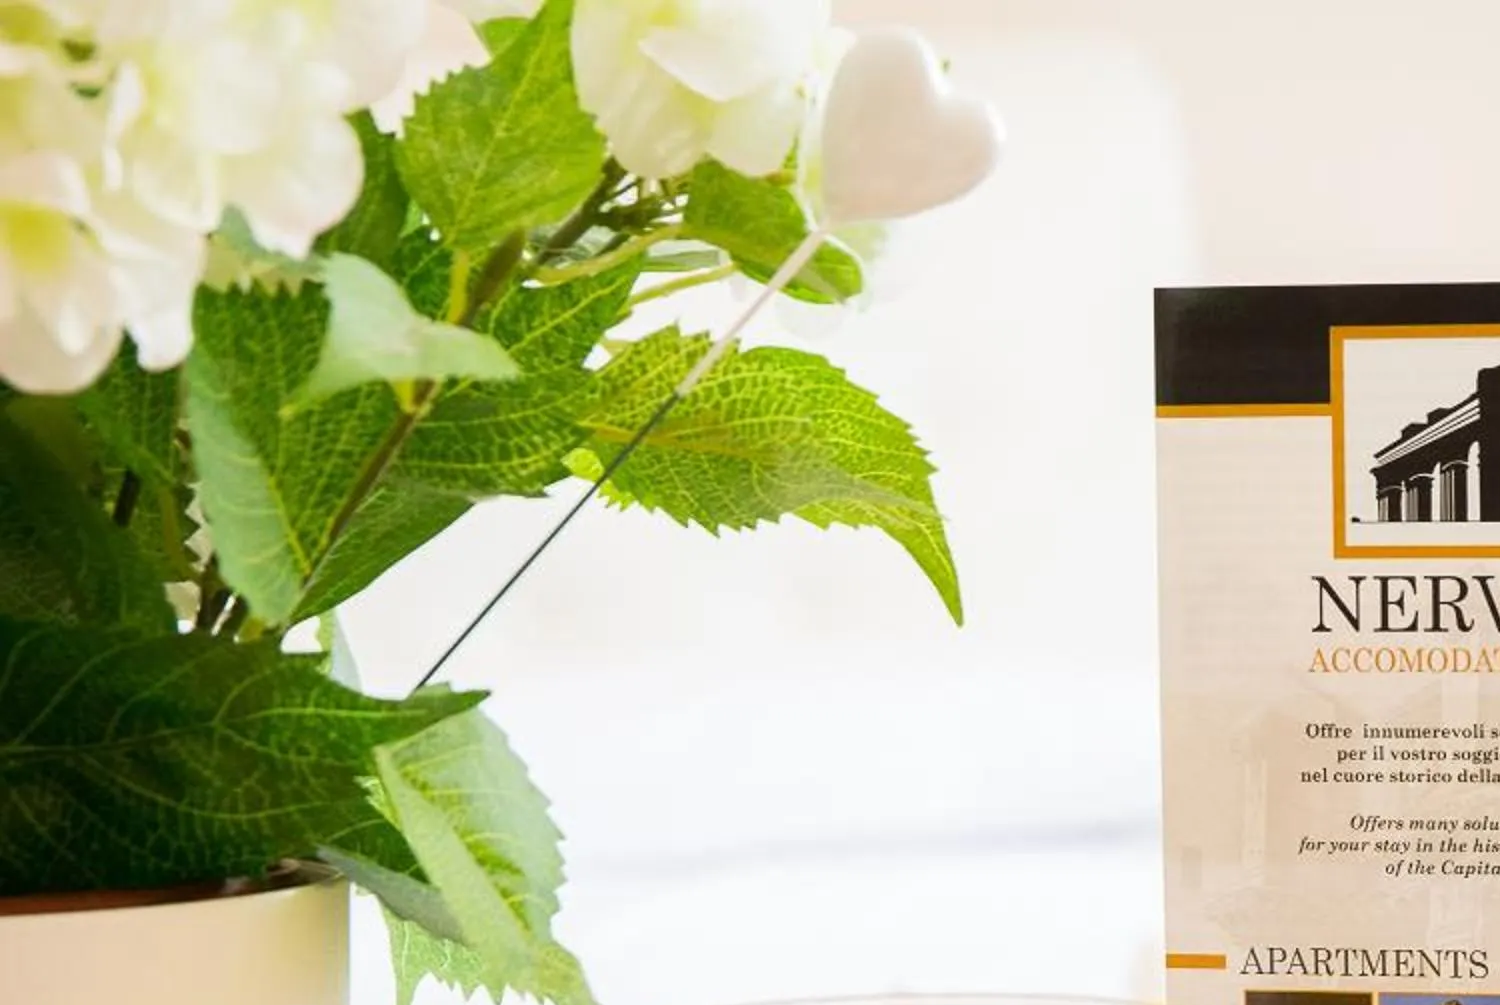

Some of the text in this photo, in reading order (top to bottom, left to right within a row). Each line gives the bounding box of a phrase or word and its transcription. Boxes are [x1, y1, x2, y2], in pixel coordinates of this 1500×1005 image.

[1305, 723, 1353, 739] Offre
[1363, 723, 1485, 739] innumerevoli
[1337, 749, 1367, 764] per
[1373, 745, 1385, 761] il
[1390, 748, 1447, 761] vostro
[1300, 767, 1328, 783] nel
[1333, 771, 1384, 783] cuore
[1389, 768, 1453, 783] storico
[1457, 768, 1500, 783] della
[1350, 814, 1404, 832] Offers
[1409, 818, 1459, 834] many
[1298, 836, 1326, 854] for
[1328, 840, 1371, 855] your
[1374, 839, 1411, 855] stay
[1416, 838, 1433, 853] in
[1439, 837, 1467, 853] the
[1385, 859, 1405, 877] of
[1407, 859, 1435, 875] the
[1240, 947, 1489, 979] APARTMENTS
